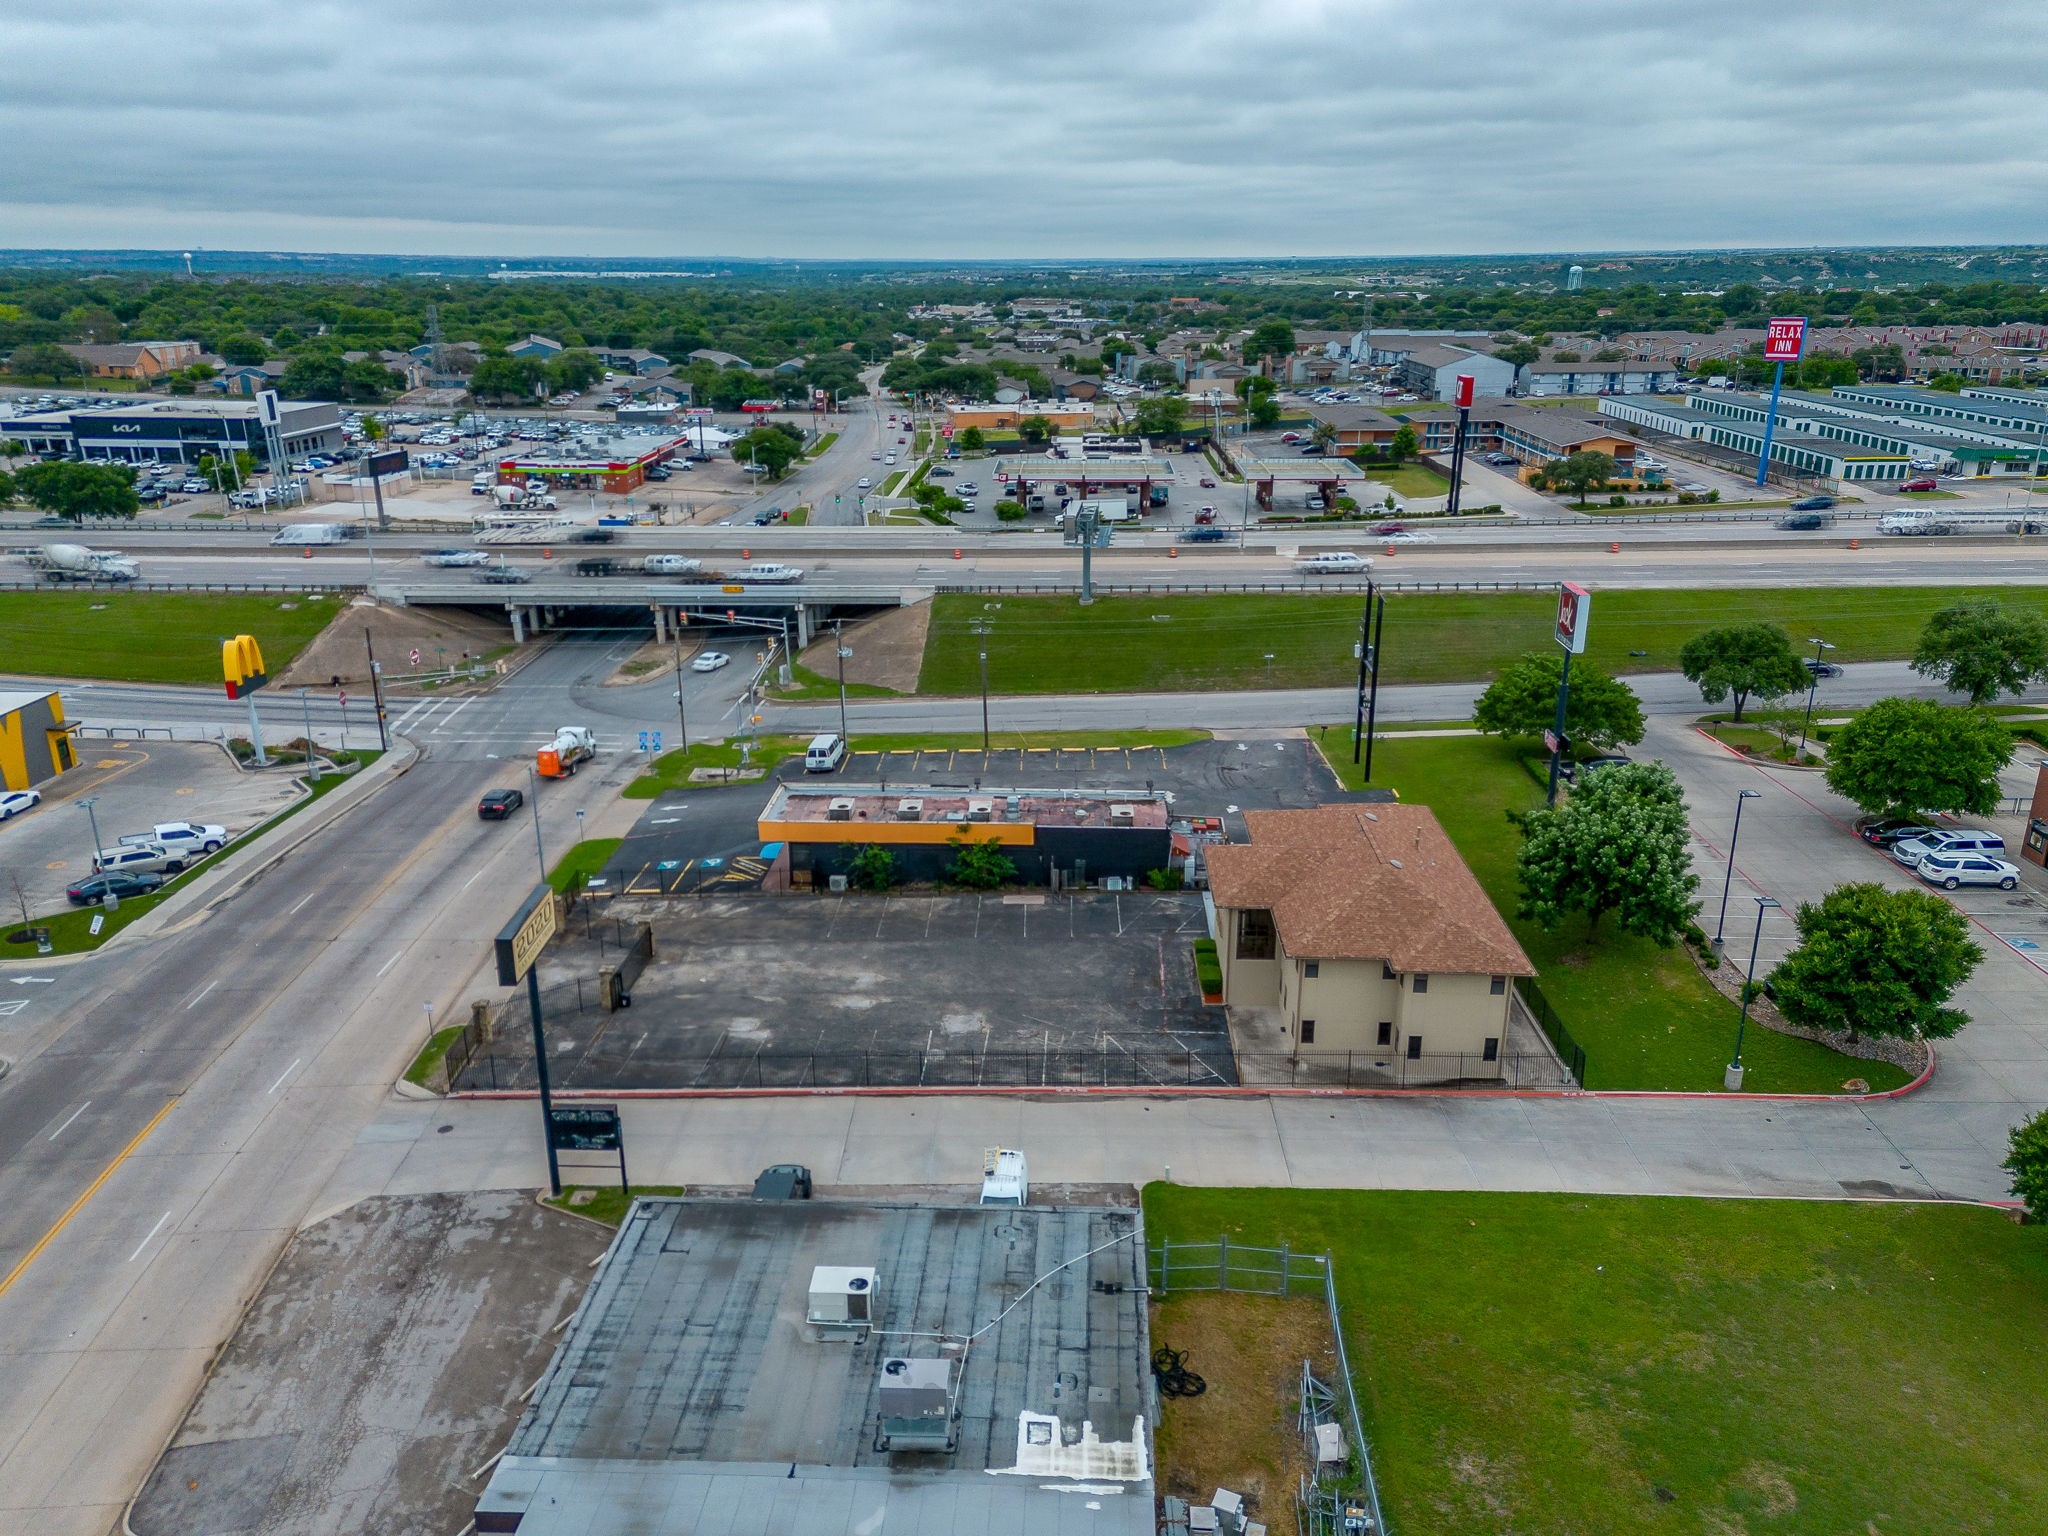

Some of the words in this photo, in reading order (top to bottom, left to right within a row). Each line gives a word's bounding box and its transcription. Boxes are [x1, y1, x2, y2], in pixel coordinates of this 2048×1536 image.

[1769, 326, 1802, 338] RELAX
[1775, 340, 1792, 352] INN
[516, 901, 552, 959] 2020
